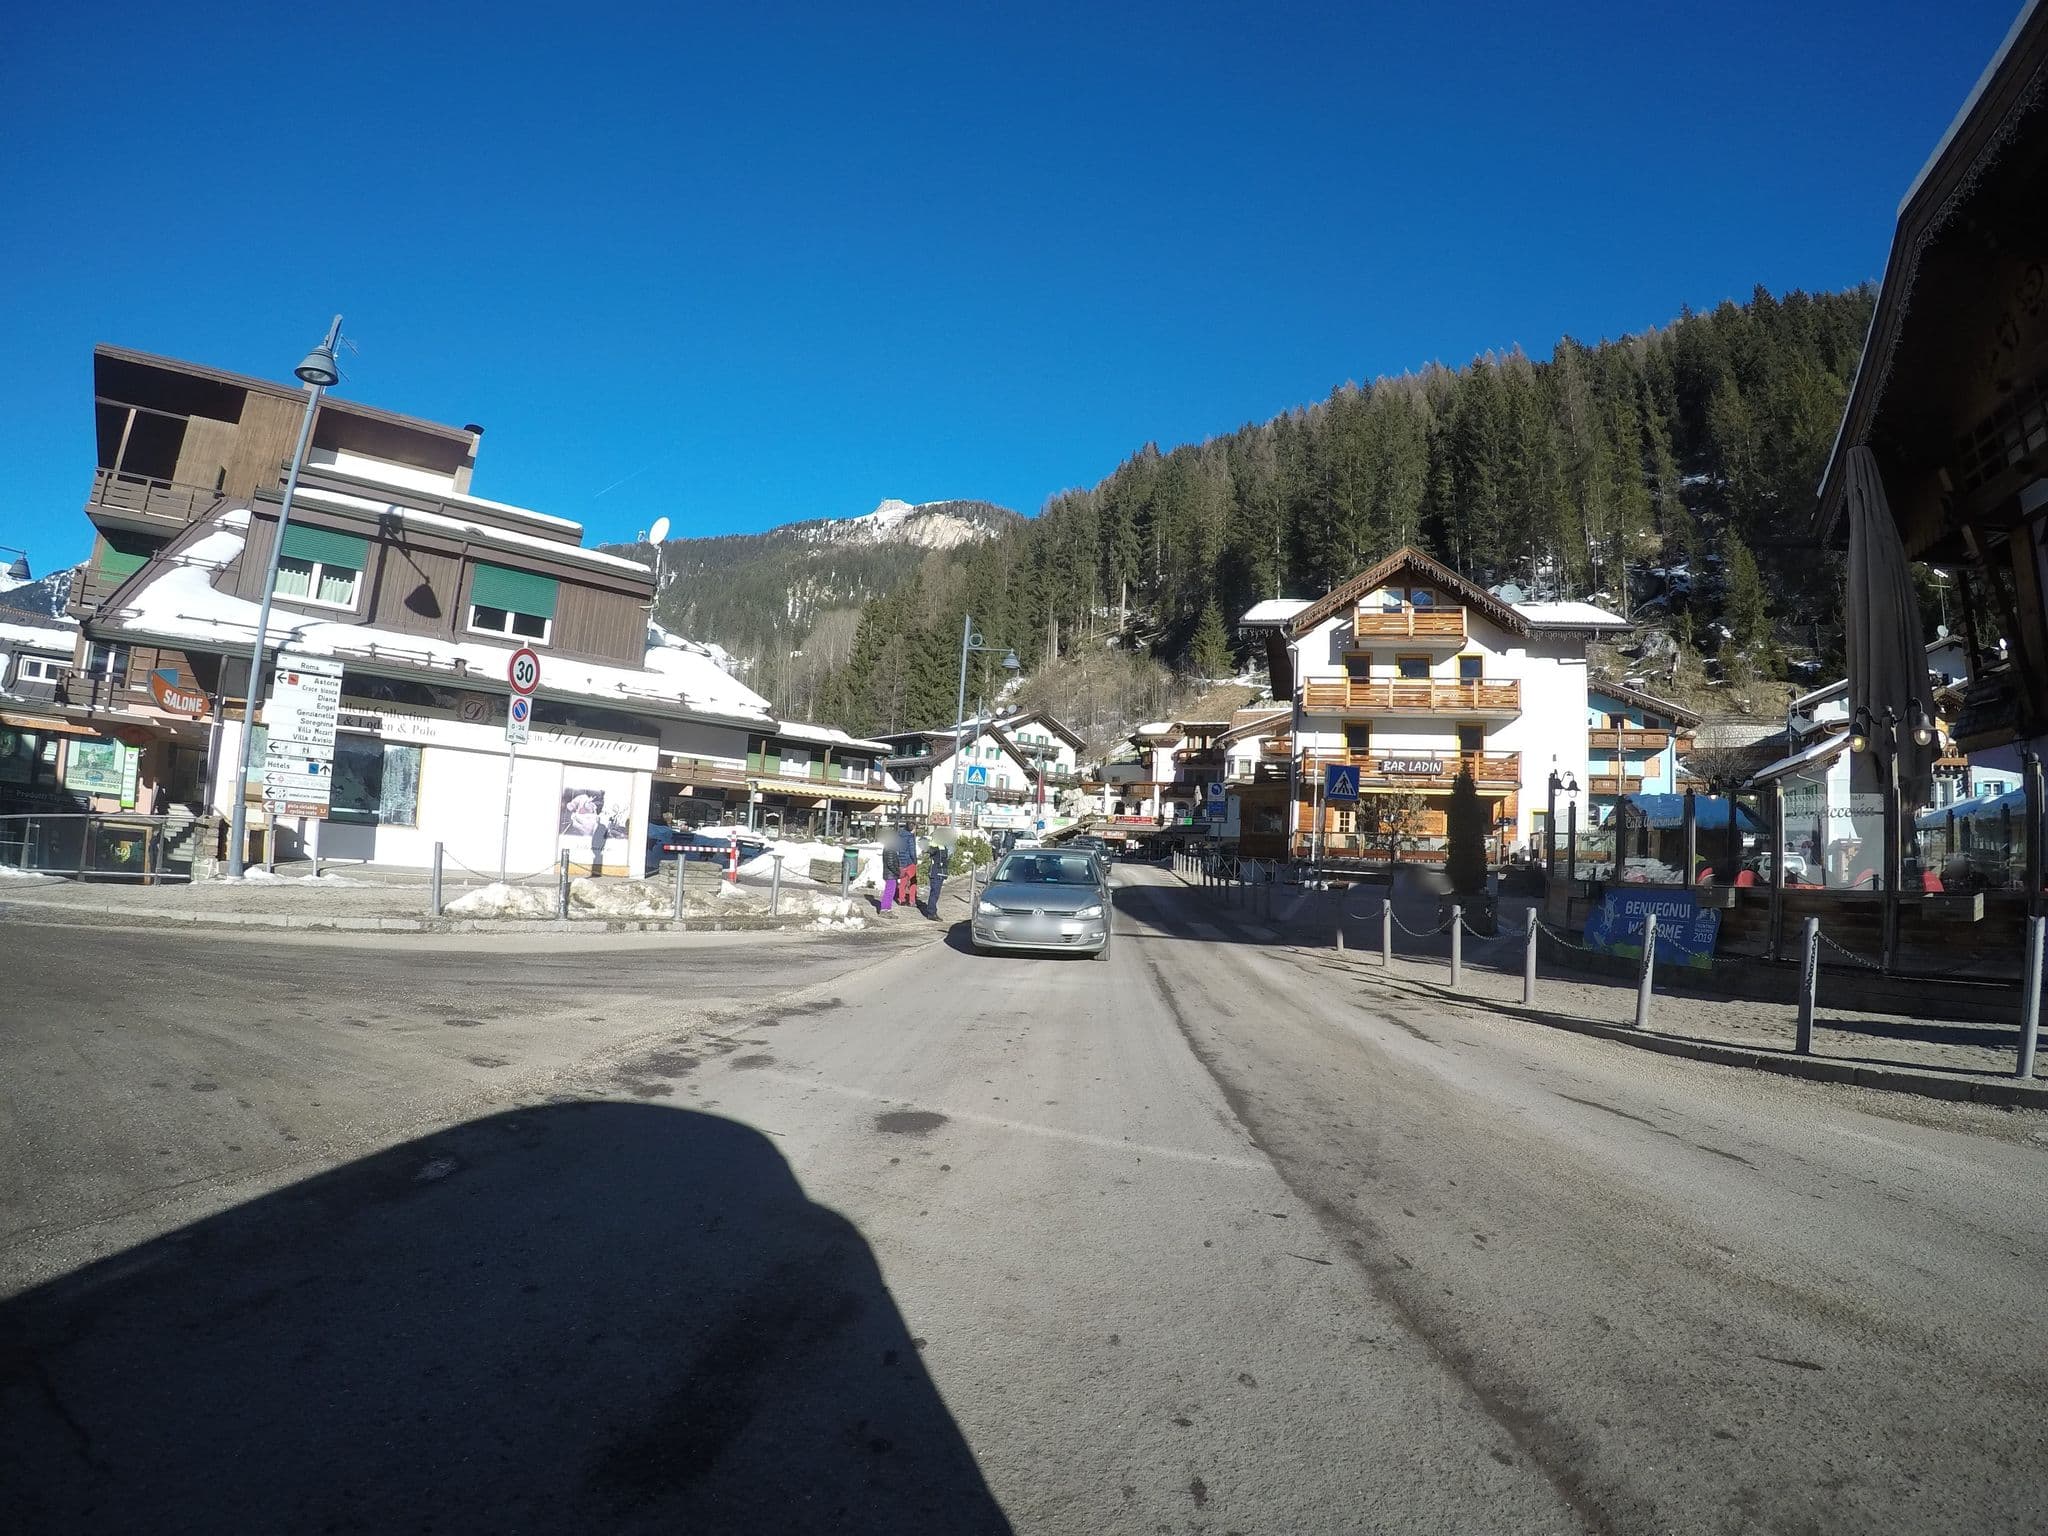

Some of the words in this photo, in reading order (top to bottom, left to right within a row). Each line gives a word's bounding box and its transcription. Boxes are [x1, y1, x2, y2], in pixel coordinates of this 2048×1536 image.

[301, 662, 320, 670] Roma
[516, 661, 533, 684] 30
[314, 678, 338, 686] Astoria
[163, 689, 204, 713] SALONE
[317, 694, 336, 703] Diana
[316, 702, 336, 711] Engel
[339, 702, 369, 715] ellent
[374, 705, 430, 723] Collection
[1383, 760, 1406, 772] BAR
[1408, 761, 1442, 772] LADIN
[1625, 900, 1691, 918] BENVEGNUI
[1692, 932, 1713, 943] 2019
